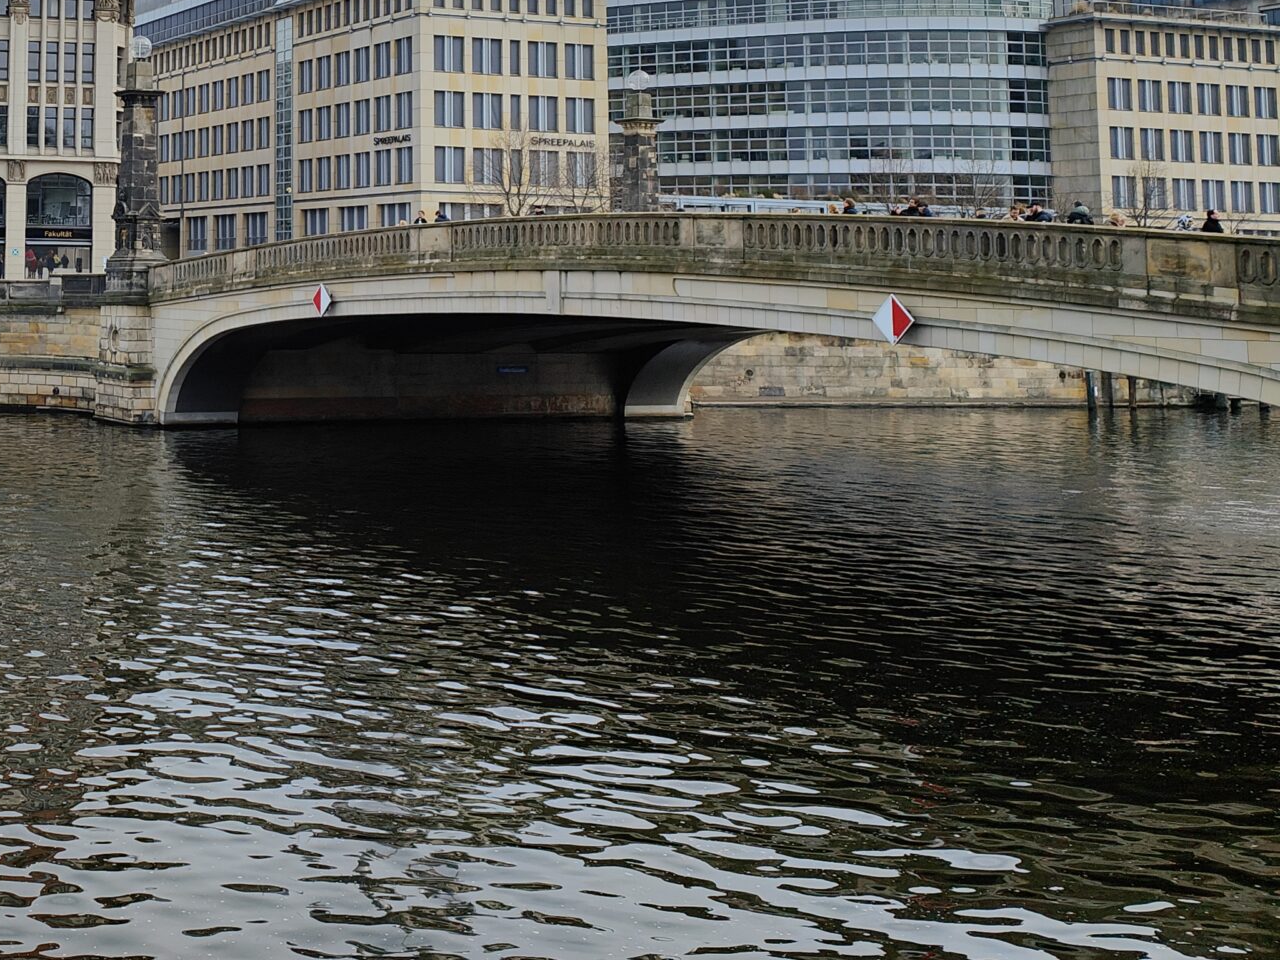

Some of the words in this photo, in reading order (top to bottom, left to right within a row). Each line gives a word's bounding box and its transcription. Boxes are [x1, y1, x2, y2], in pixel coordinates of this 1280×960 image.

[373, 134, 411, 146] SPREEPALAIS
[531, 136, 595, 148] SPREEPALAIS
[44, 230, 73, 238] Fakultät
